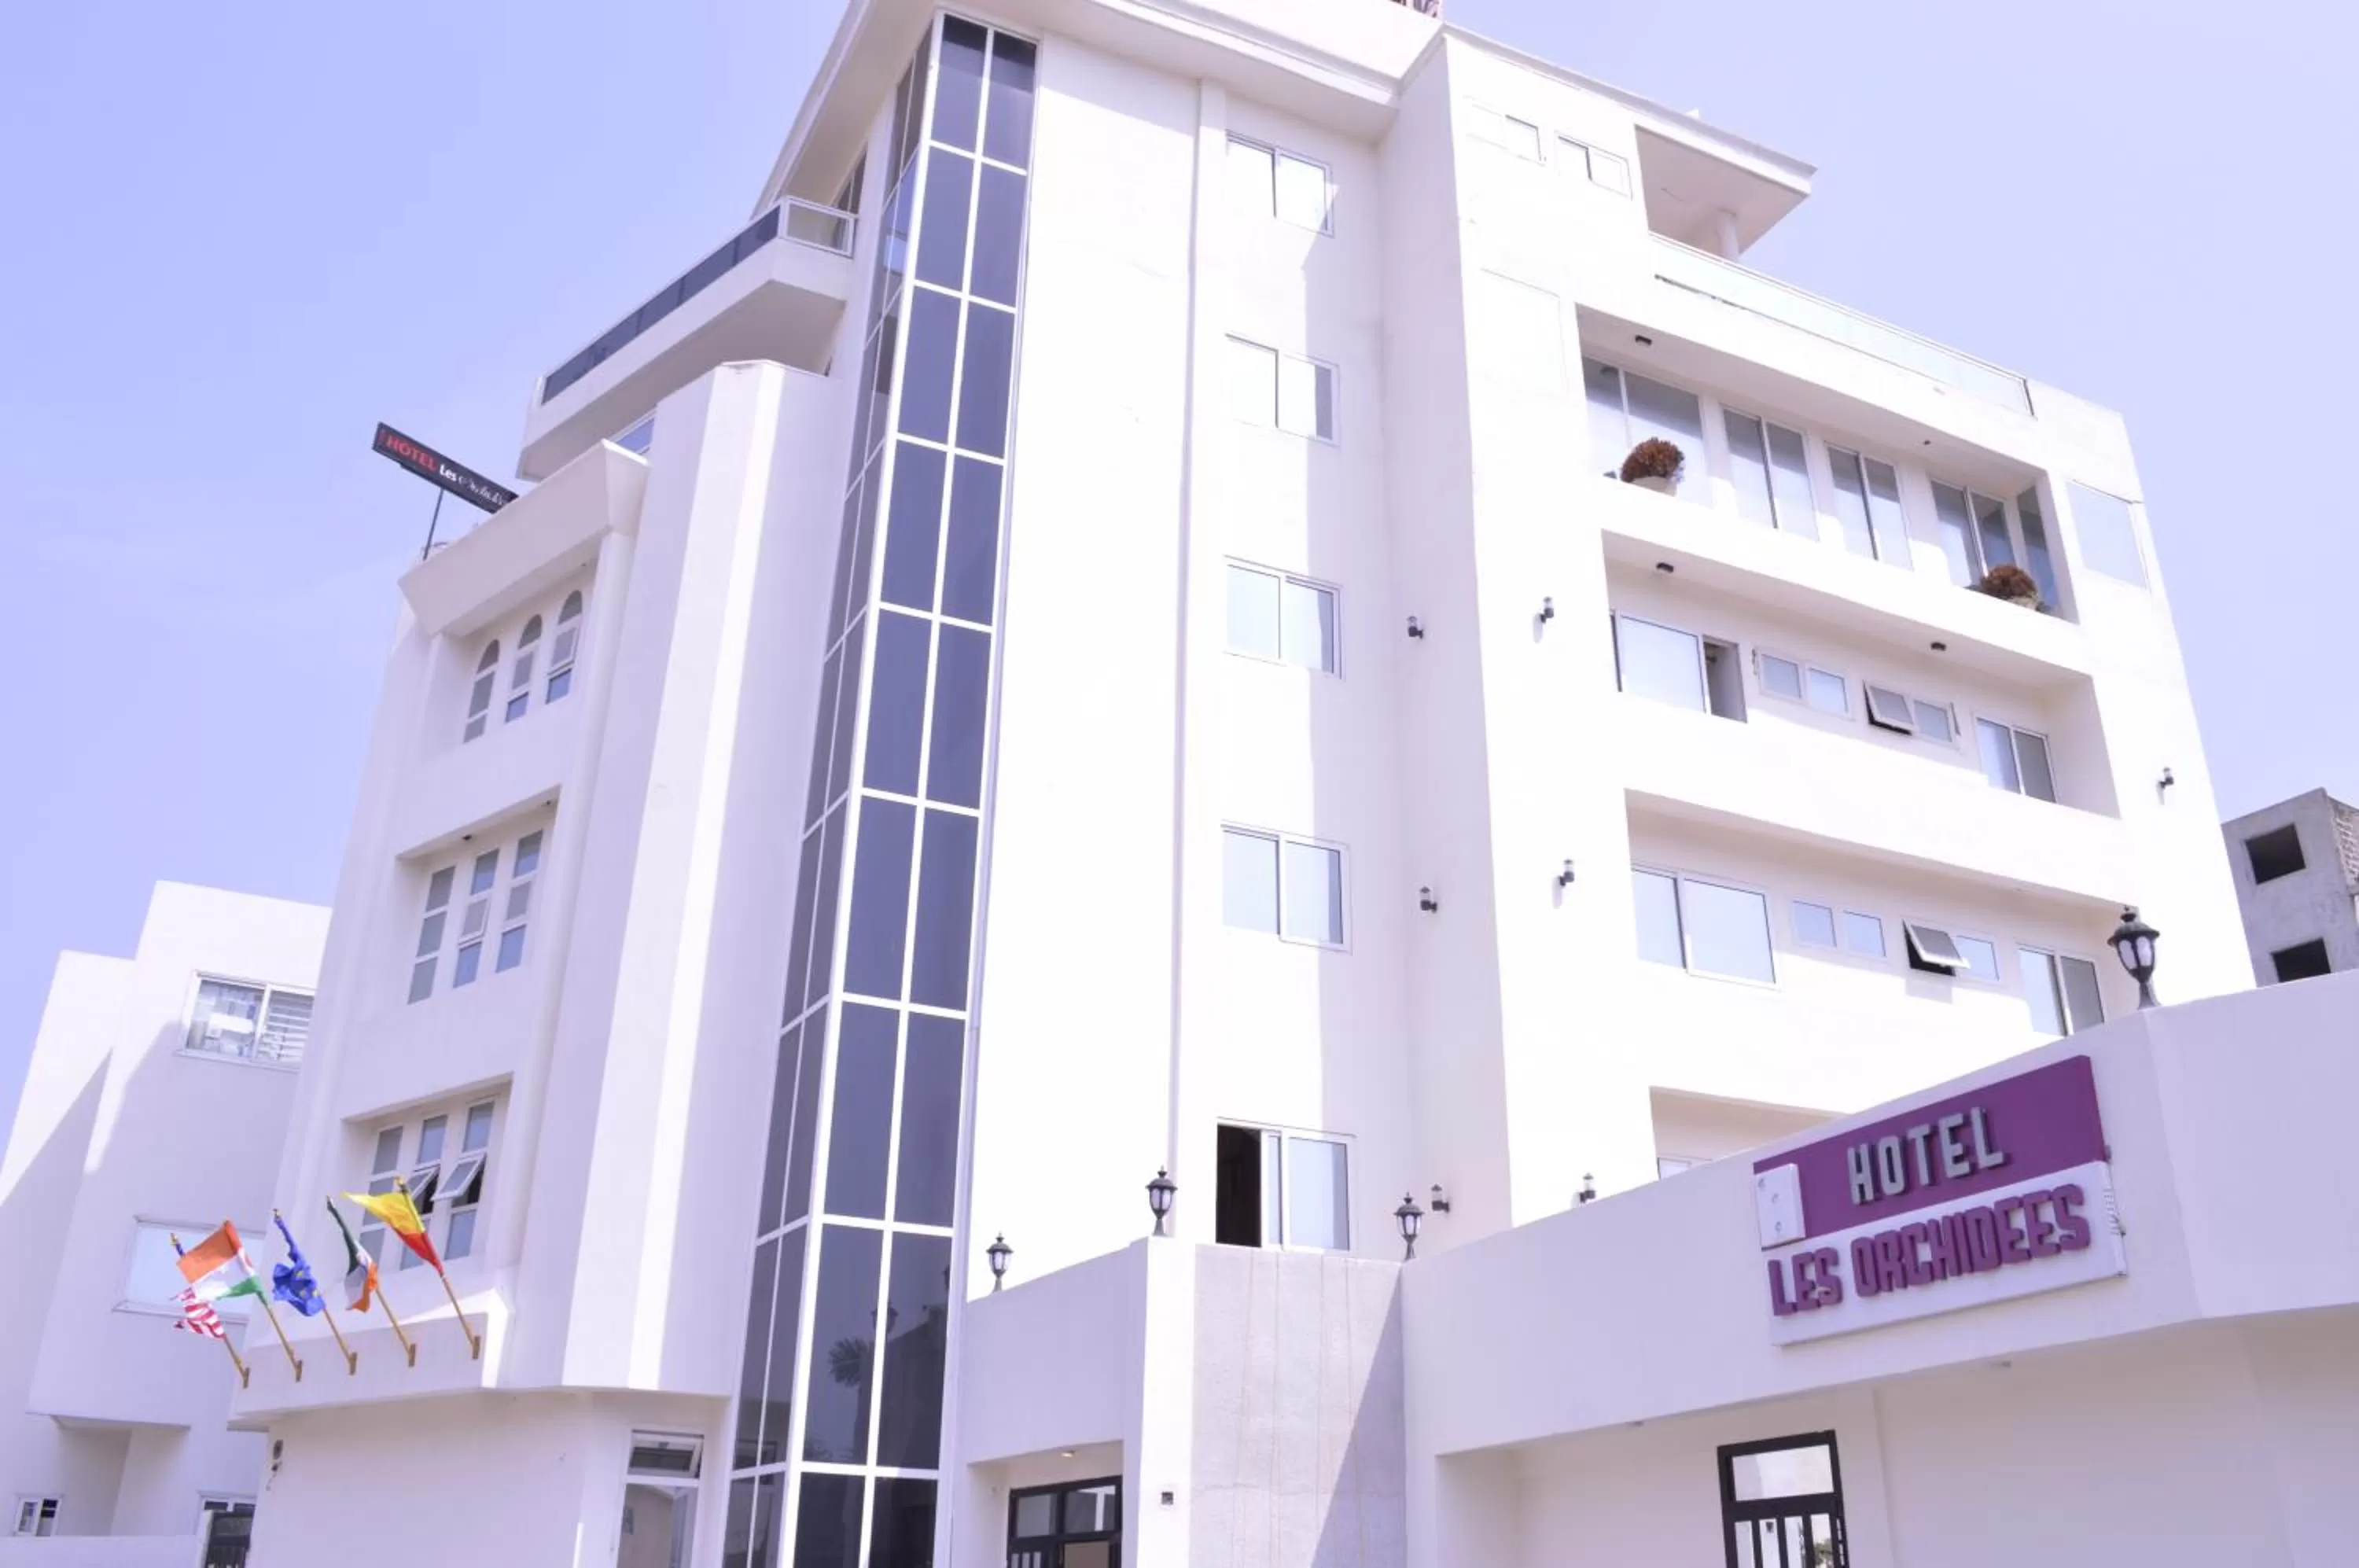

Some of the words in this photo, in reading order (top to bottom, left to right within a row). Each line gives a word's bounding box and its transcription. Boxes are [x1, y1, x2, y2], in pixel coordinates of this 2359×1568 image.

[386, 435, 437, 472] HOTEL
[439, 463, 457, 482] Les
[1846, 1106, 2008, 1205] HOTEL
[1768, 1246, 1843, 1316] LES
[1849, 1183, 2092, 1298] ORCHIDEES
